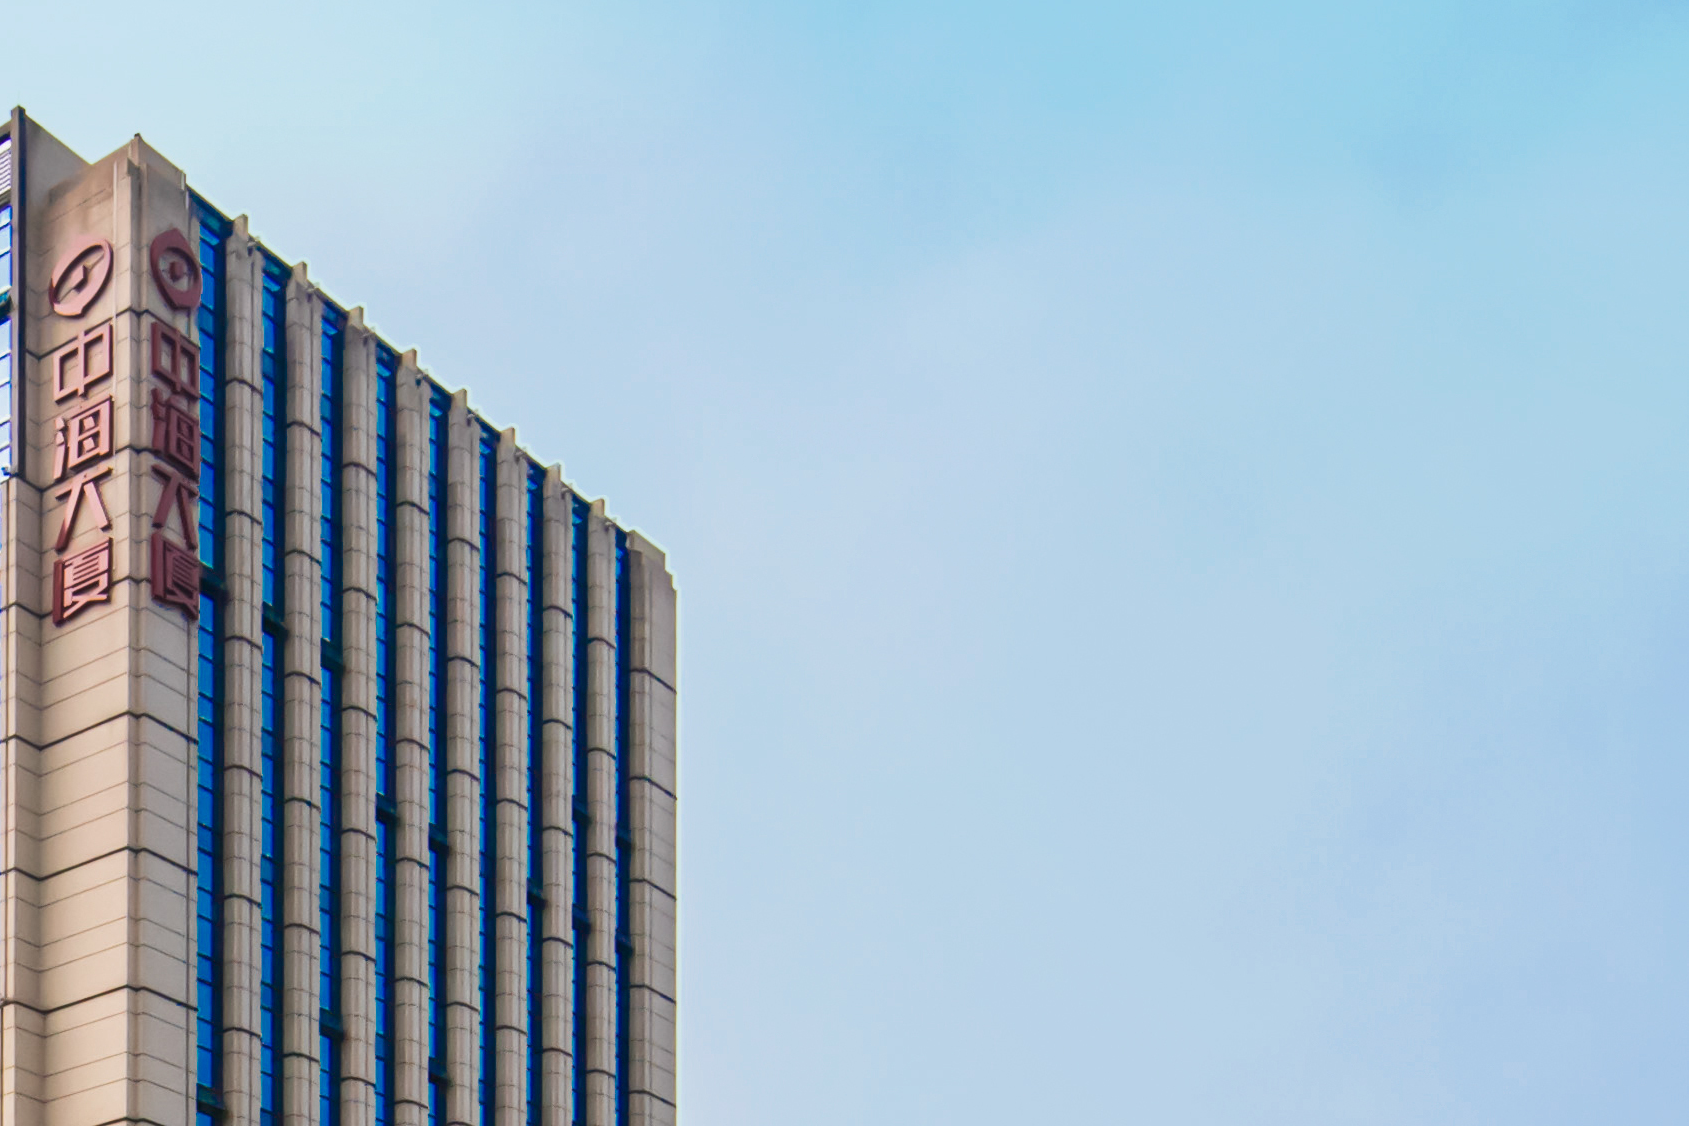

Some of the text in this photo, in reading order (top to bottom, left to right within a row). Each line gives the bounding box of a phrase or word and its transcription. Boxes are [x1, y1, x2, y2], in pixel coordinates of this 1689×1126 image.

[52, 320, 114, 627] 中海大厦
[150, 320, 201, 621] 中海大厦
